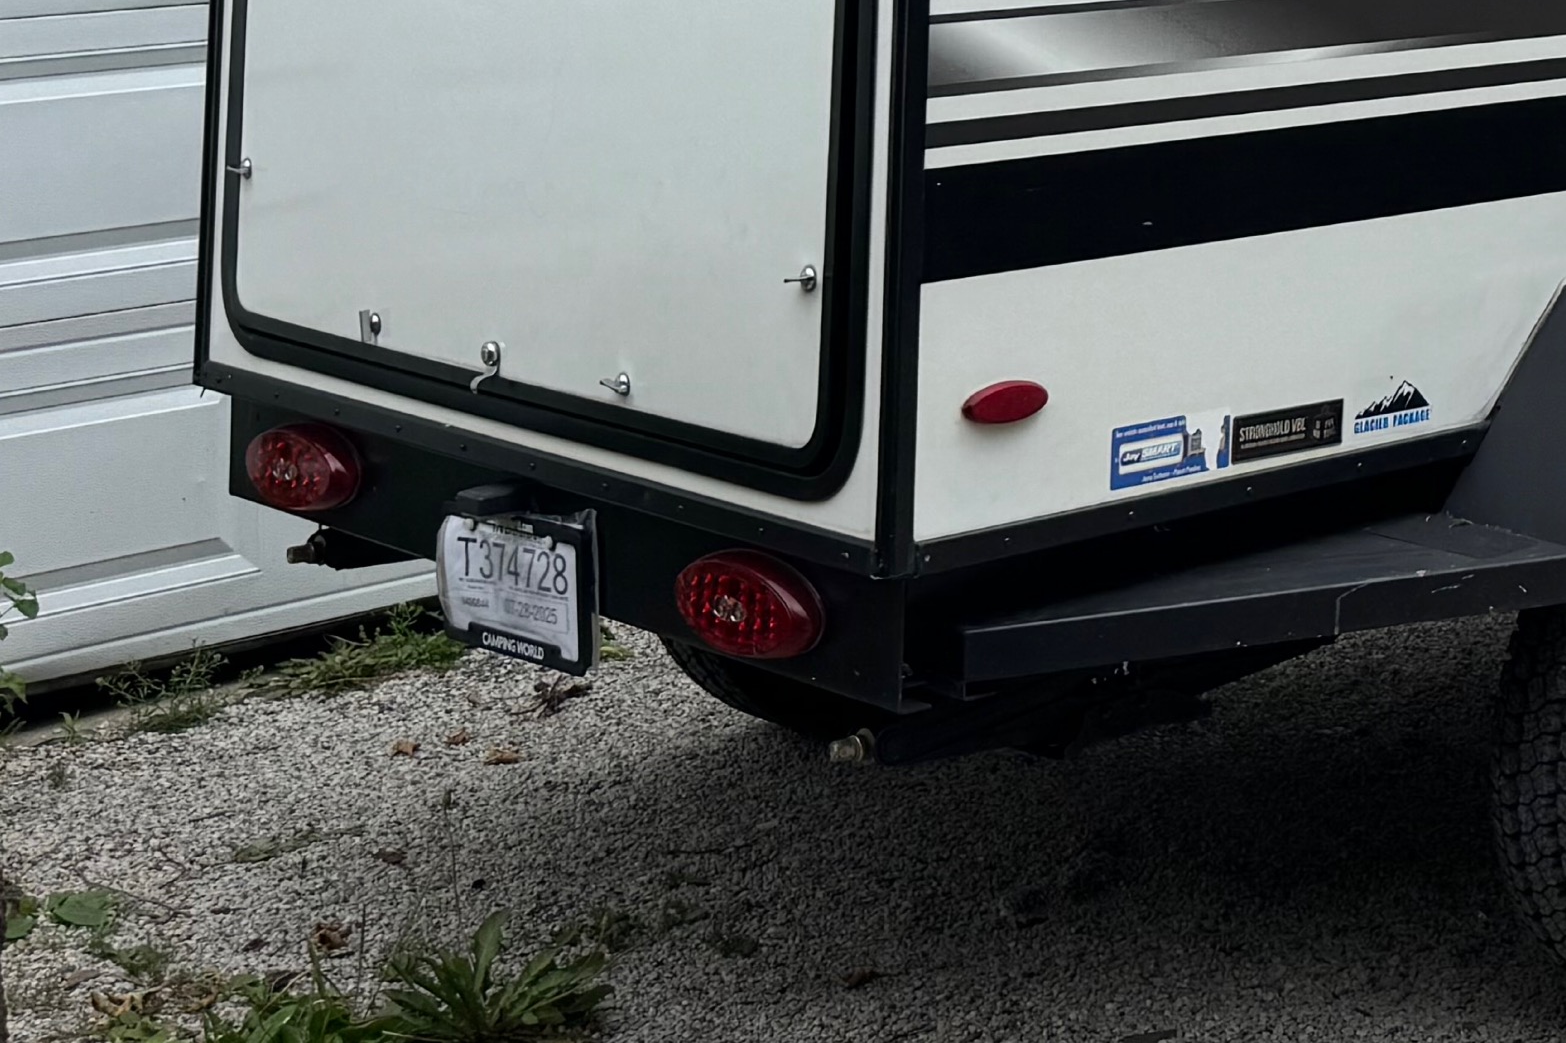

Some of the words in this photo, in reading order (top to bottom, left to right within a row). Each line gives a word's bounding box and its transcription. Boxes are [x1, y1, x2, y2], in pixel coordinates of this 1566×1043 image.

[457, 536, 569, 595] T374728
[482, 631, 516, 653] CAMPING
[516, 640, 545, 660] WORLD
